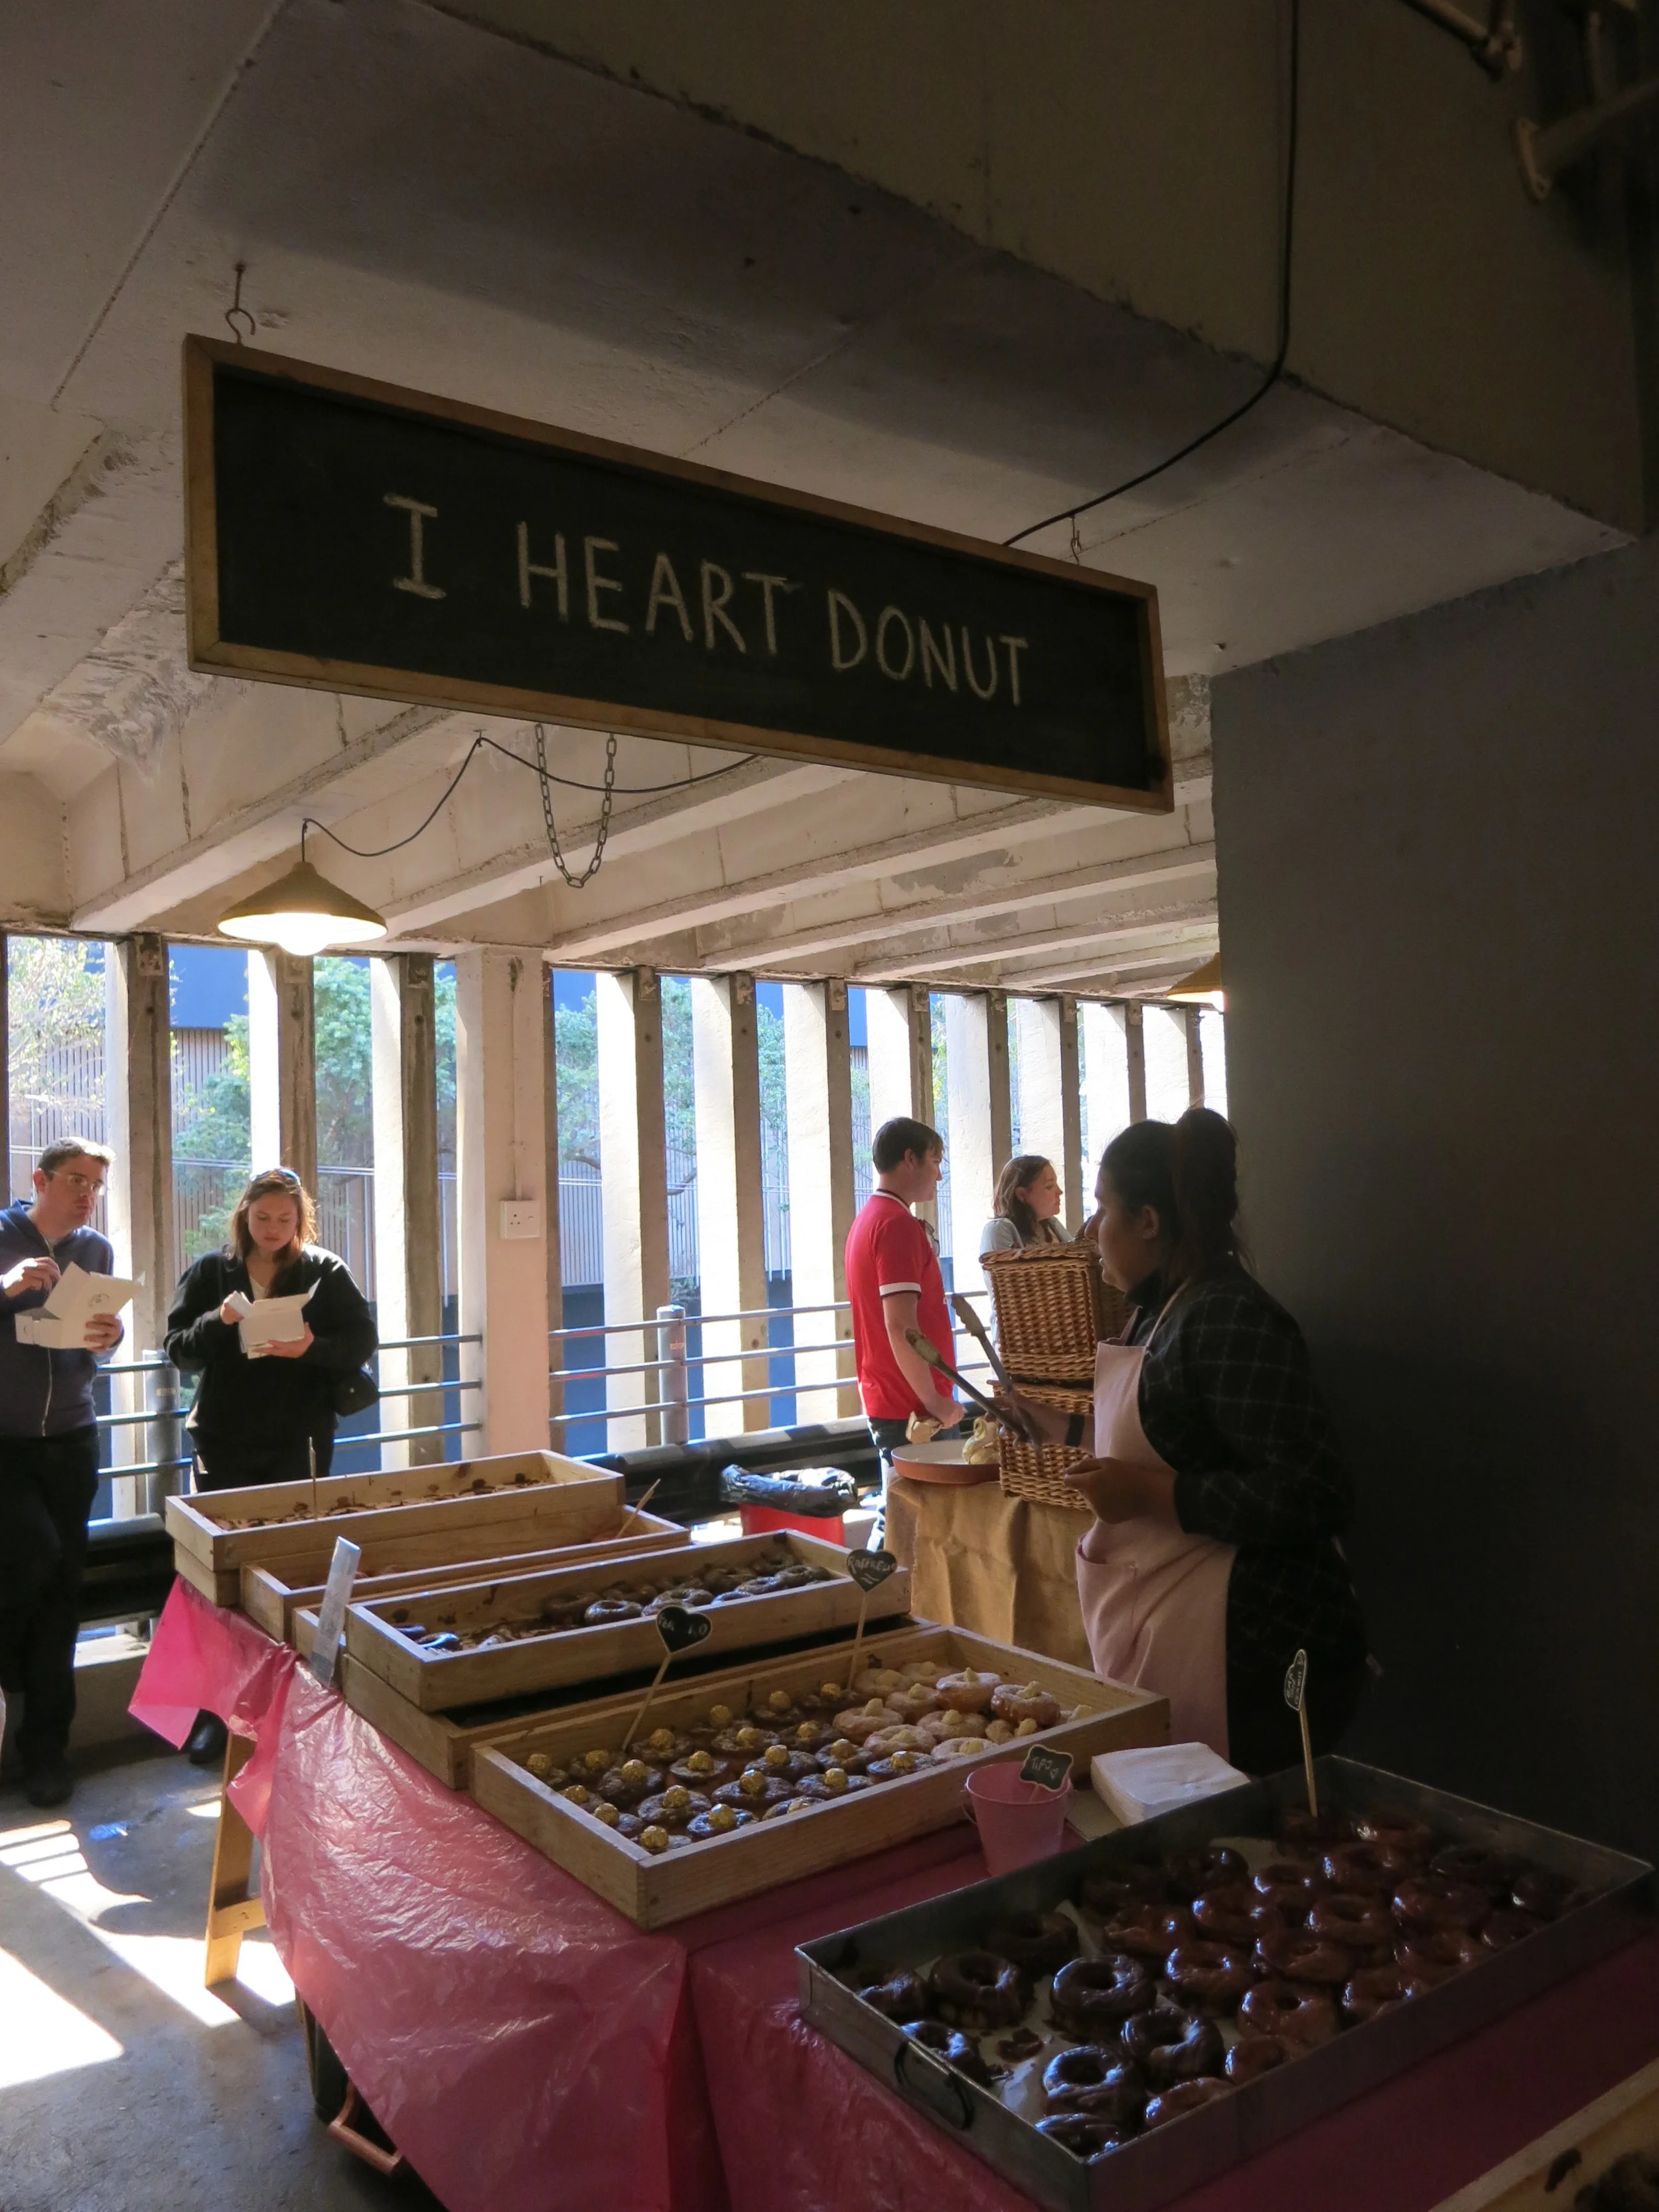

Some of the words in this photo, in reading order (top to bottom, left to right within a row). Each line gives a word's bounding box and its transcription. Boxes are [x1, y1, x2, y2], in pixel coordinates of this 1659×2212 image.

[383, 494, 447, 601] I
[516, 520, 791, 656] HEART
[827, 589, 1029, 706] DONUT
